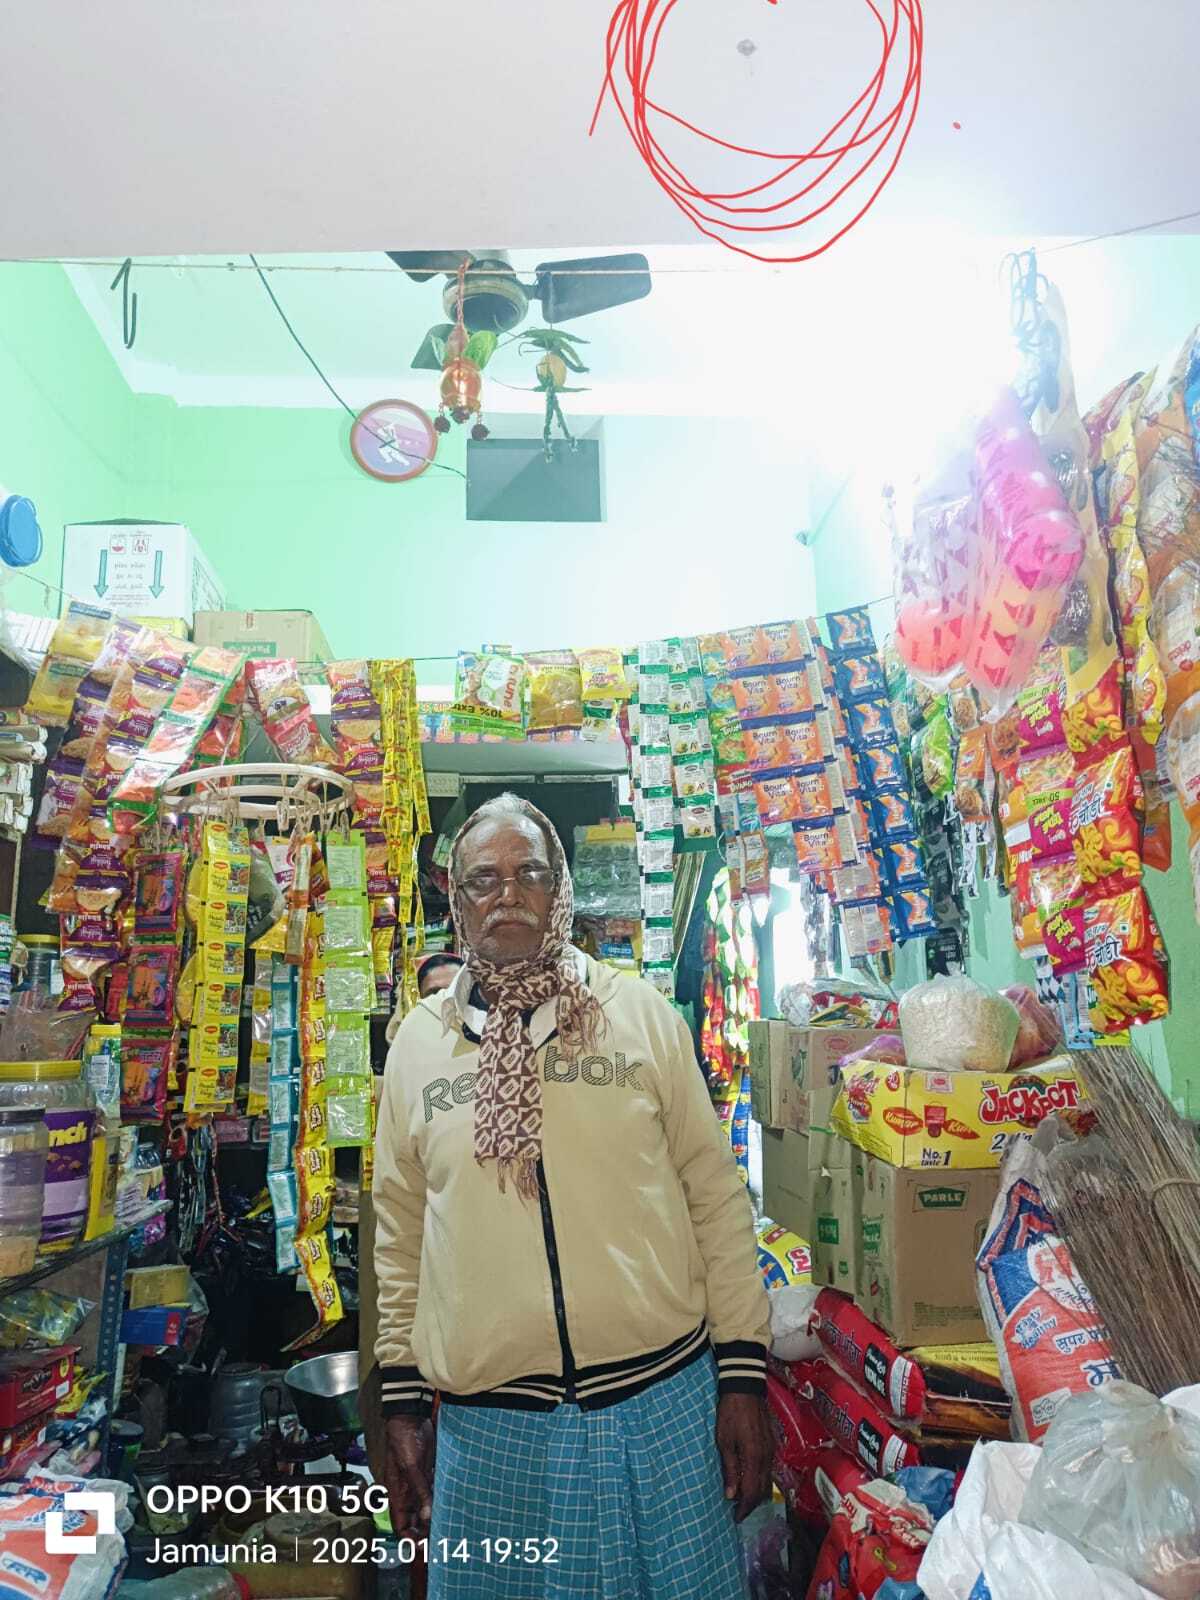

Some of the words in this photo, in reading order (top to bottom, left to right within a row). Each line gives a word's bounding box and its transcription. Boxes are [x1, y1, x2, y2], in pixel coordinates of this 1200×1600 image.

[451, 703, 477, 714] Extr
[480, 707, 503, 719] 10%
[803, 832, 829, 842] Bourn
[422, 1046, 644, 1123] Rebok
[979, 1079, 1080, 1124] JACKPOT
[921, 1148, 942, 1160] No.
[942, 1150, 953, 1167] 1
[923, 1192, 962, 1203] PARLE
[1021, 1317, 1058, 1350] Healthy
[1055, 1331, 1088, 1353] सुपर
